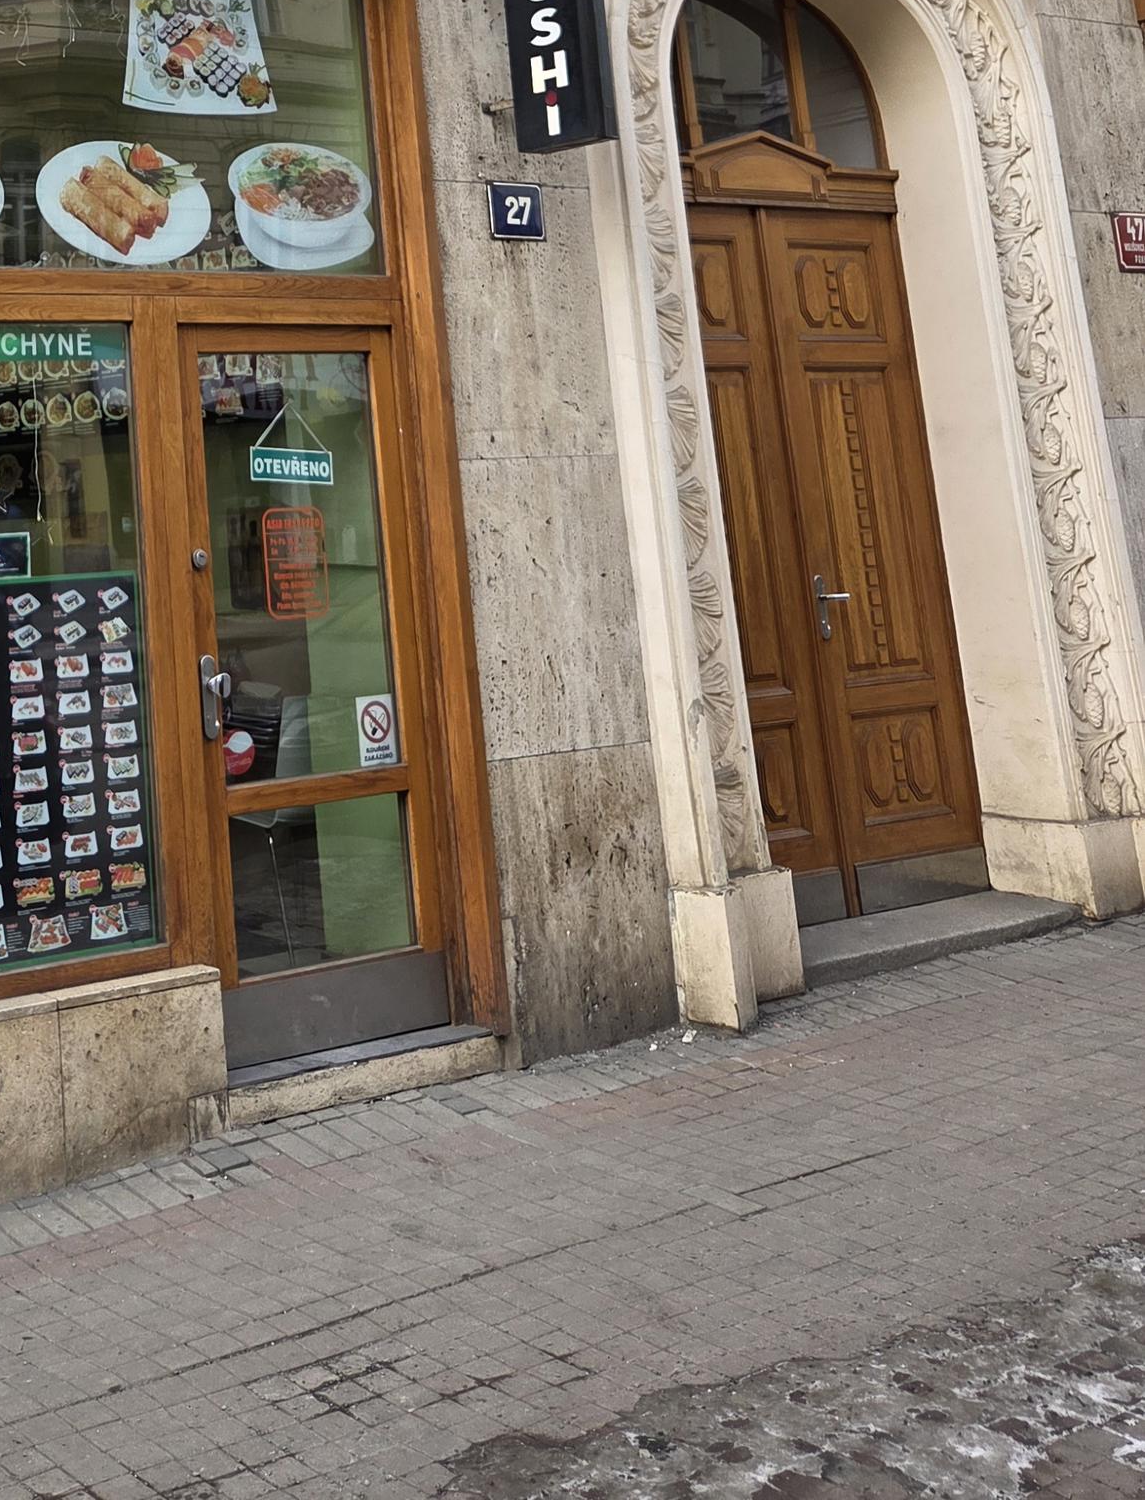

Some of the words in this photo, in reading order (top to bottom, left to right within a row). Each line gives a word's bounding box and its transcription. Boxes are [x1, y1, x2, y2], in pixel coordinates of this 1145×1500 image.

[504, 195, 532, 226] 27
[1126, 216, 1145, 242] 47
[254, 455, 330, 479] OTEVŘENO
